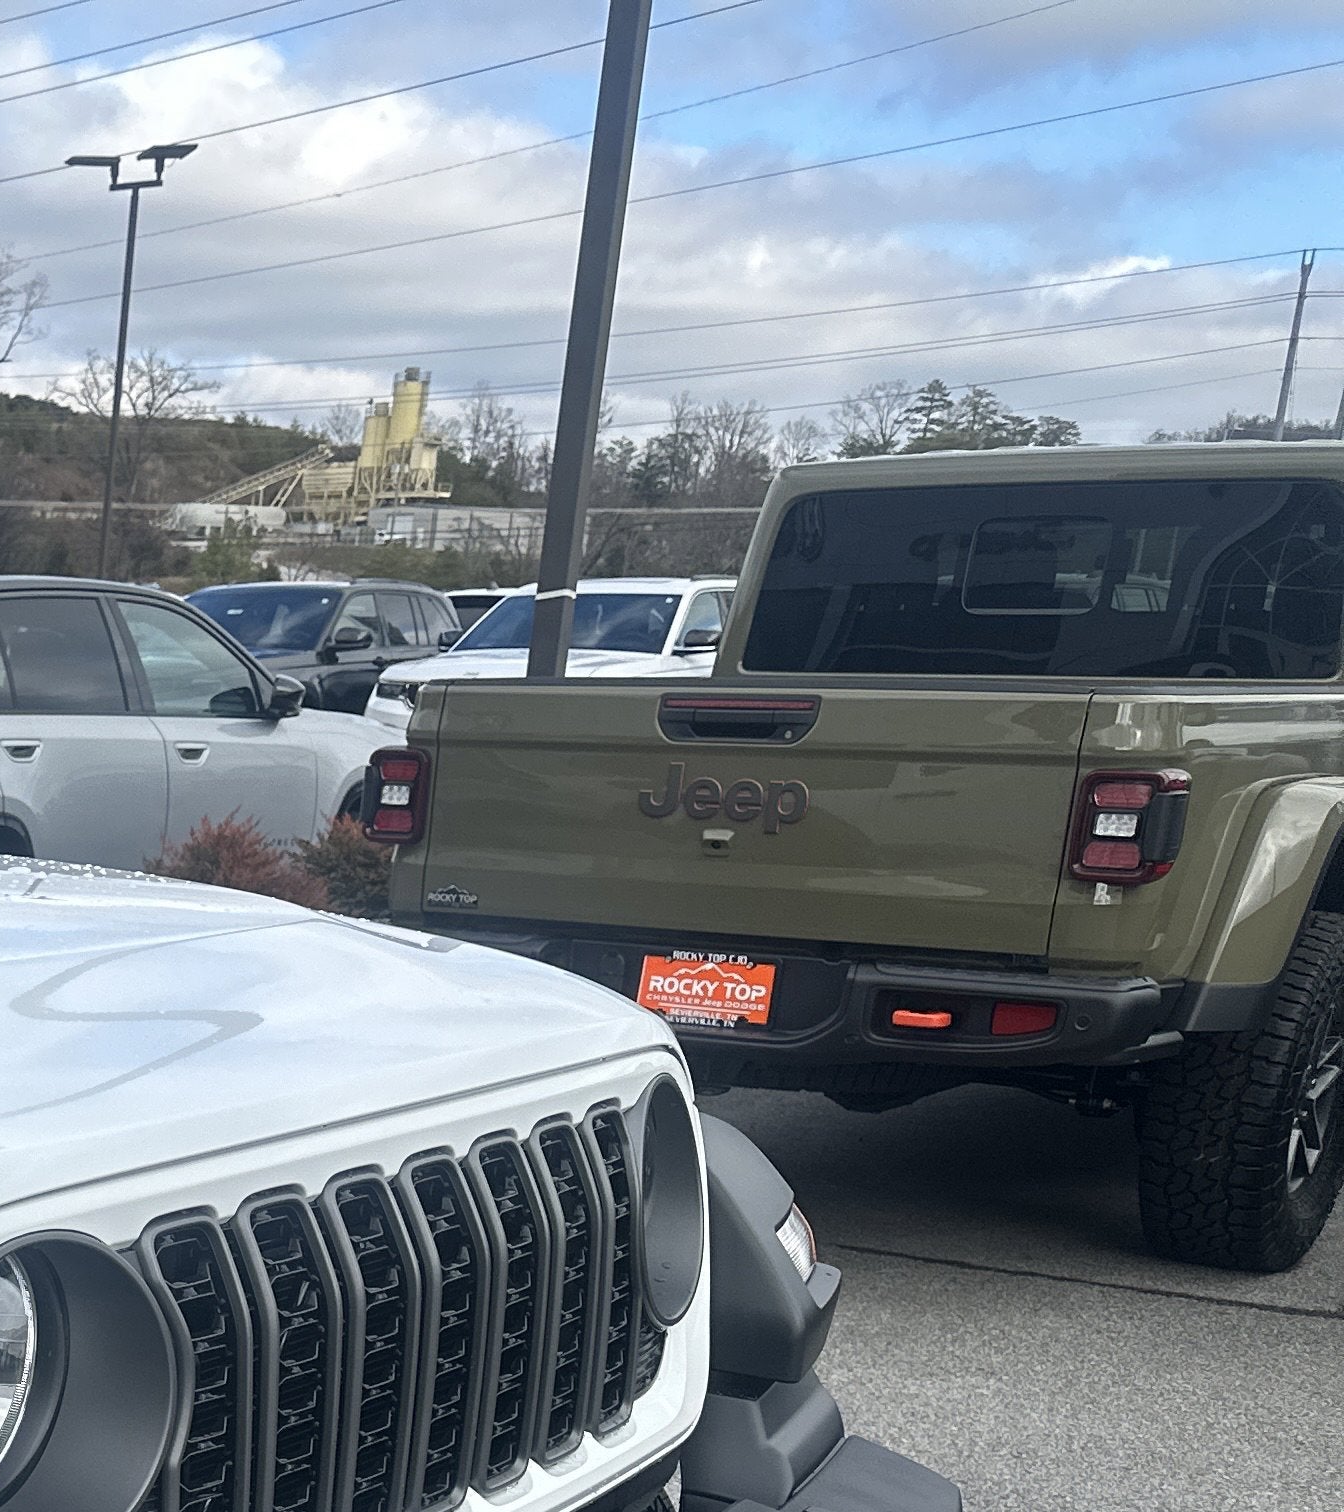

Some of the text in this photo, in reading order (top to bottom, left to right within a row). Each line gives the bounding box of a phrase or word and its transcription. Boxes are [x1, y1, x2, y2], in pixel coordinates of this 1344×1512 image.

[638, 761, 810, 835] Jeep
[427, 892, 478, 904] ROCKY TOP
[673, 950, 705, 962] ROCKY
[708, 952, 727, 963] TOP
[648, 975, 767, 1002] ROCKY TOP
[645, 993, 767, 1011] CHRYSLER Jeep DODGE
[726, 1013, 739, 1021] TN
[723, 1020, 736, 1028] TN
